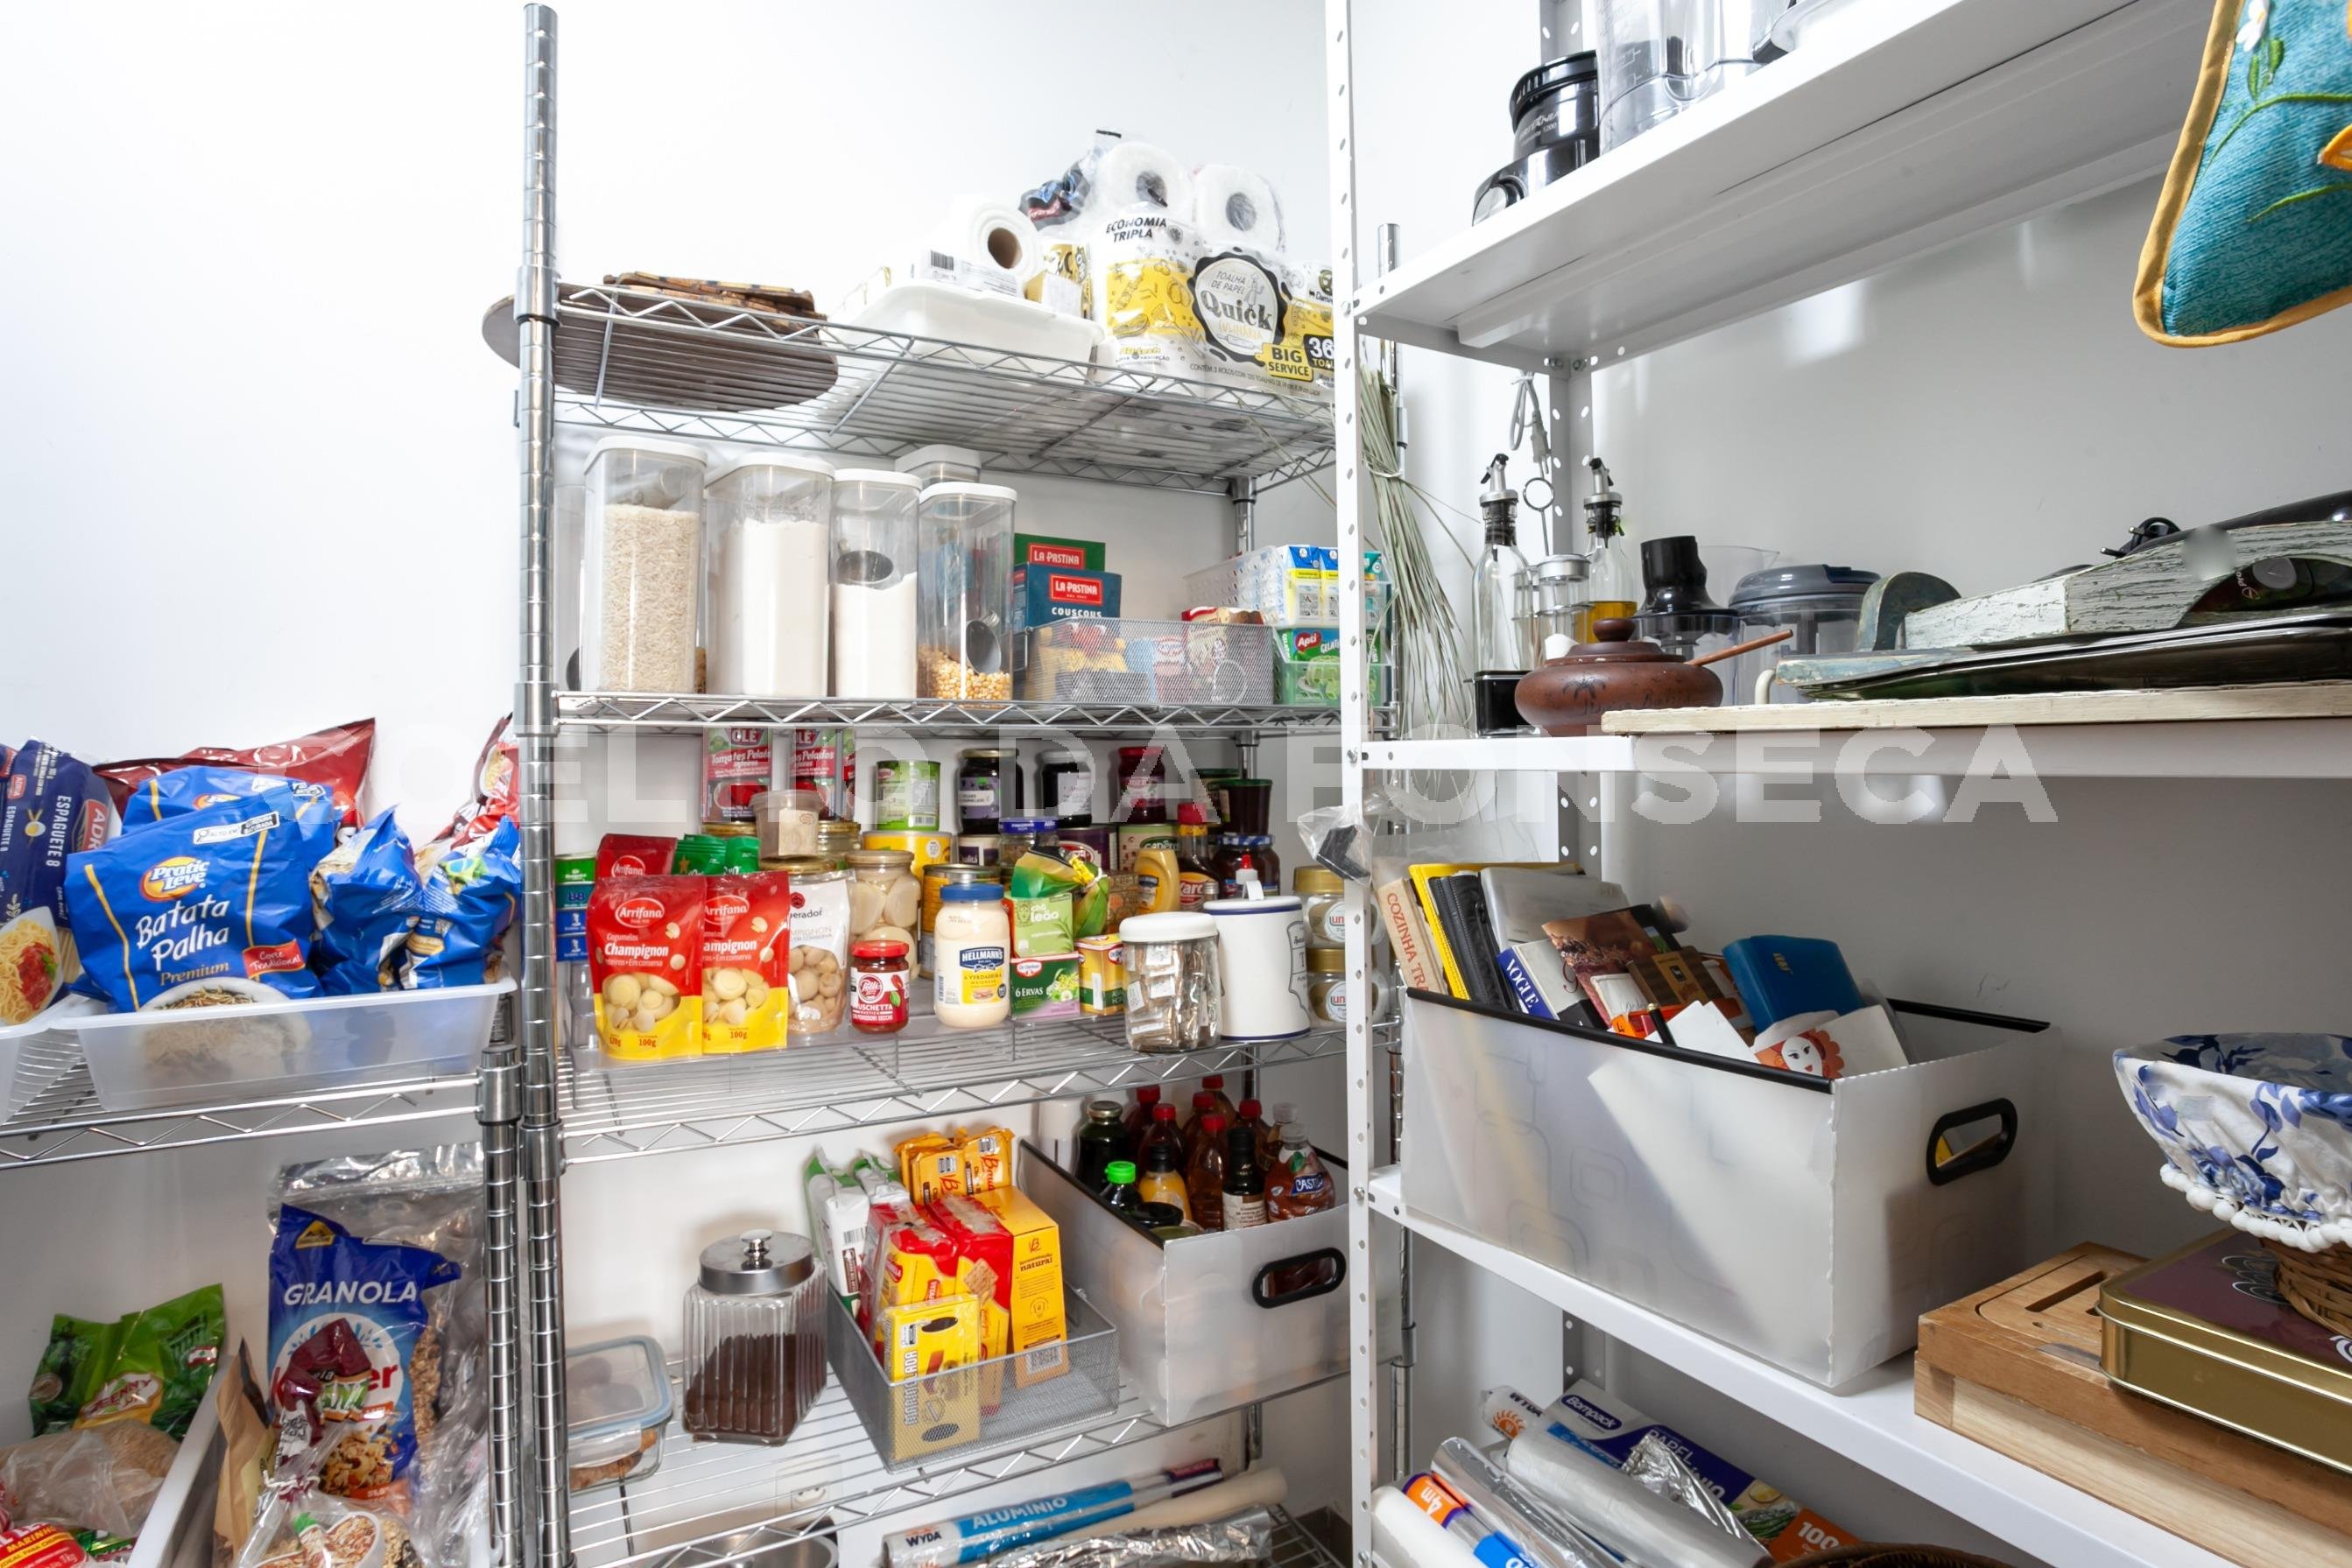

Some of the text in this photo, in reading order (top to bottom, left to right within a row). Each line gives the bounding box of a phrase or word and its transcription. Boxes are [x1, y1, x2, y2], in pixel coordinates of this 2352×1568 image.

[1106, 217, 1167, 234] ECONOMIA
[1113, 229, 1153, 243] TRIPLA
[1216, 271, 1247, 285] TOALHA
[1211, 280, 1245, 295] DE PAPEL
[1201, 290, 1273, 332] Quick
[1272, 348, 1303, 363] BIG
[1190, 363, 1212, 373] CONTÊM
[1269, 362, 1310, 377] SERVICE
[1034, 550, 1080, 566] LA PASTINA
[1055, 580, 1098, 595] LA PASTINA
[1052, 607, 1102, 617] COUSCOUS
[1298, 633, 1317, 648] Apti
[711, 751, 746, 765] Tomates
[802, 749, 834, 760] Pelados
[12, 776, 25, 798] ADRIA
[47, 795, 72, 861] ESPAGUETE
[86, 807, 107, 850] ADR
[151, 859, 210, 882] Pratic
[614, 863, 644, 875] Arrifana
[165, 872, 208, 891] Leve
[619, 906, 662, 918] Arrifana
[1031, 909, 1060, 923] leão
[136, 894, 230, 950] Batata
[1387, 892, 1417, 963] COZINHA
[606, 932, 638, 942] Cogumelos
[151, 924, 229, 972] Palha
[259, 950, 283, 960] Corte
[604, 943, 669, 960] Champignon
[703, 939, 757, 956] ampignon
[250, 953, 301, 972] Tradicional
[962, 951, 1003, 962] HELLMANN'S
[160, 962, 229, 987] Premium
[1505, 958, 1539, 1009] VOGUE
[1015, 987, 1044, 998] 6 ERVAS
[638, 1036, 657, 1047] 100g
[729, 1030, 748, 1040] 100g
[1020, 1257, 1053, 1272] natural
[284, 1280, 418, 1307] GRANOLA
[1566, 1396, 1617, 1429] Bompack
[905, 1530, 942, 1547] WYDA
[1797, 1521, 1840, 1551] 100
